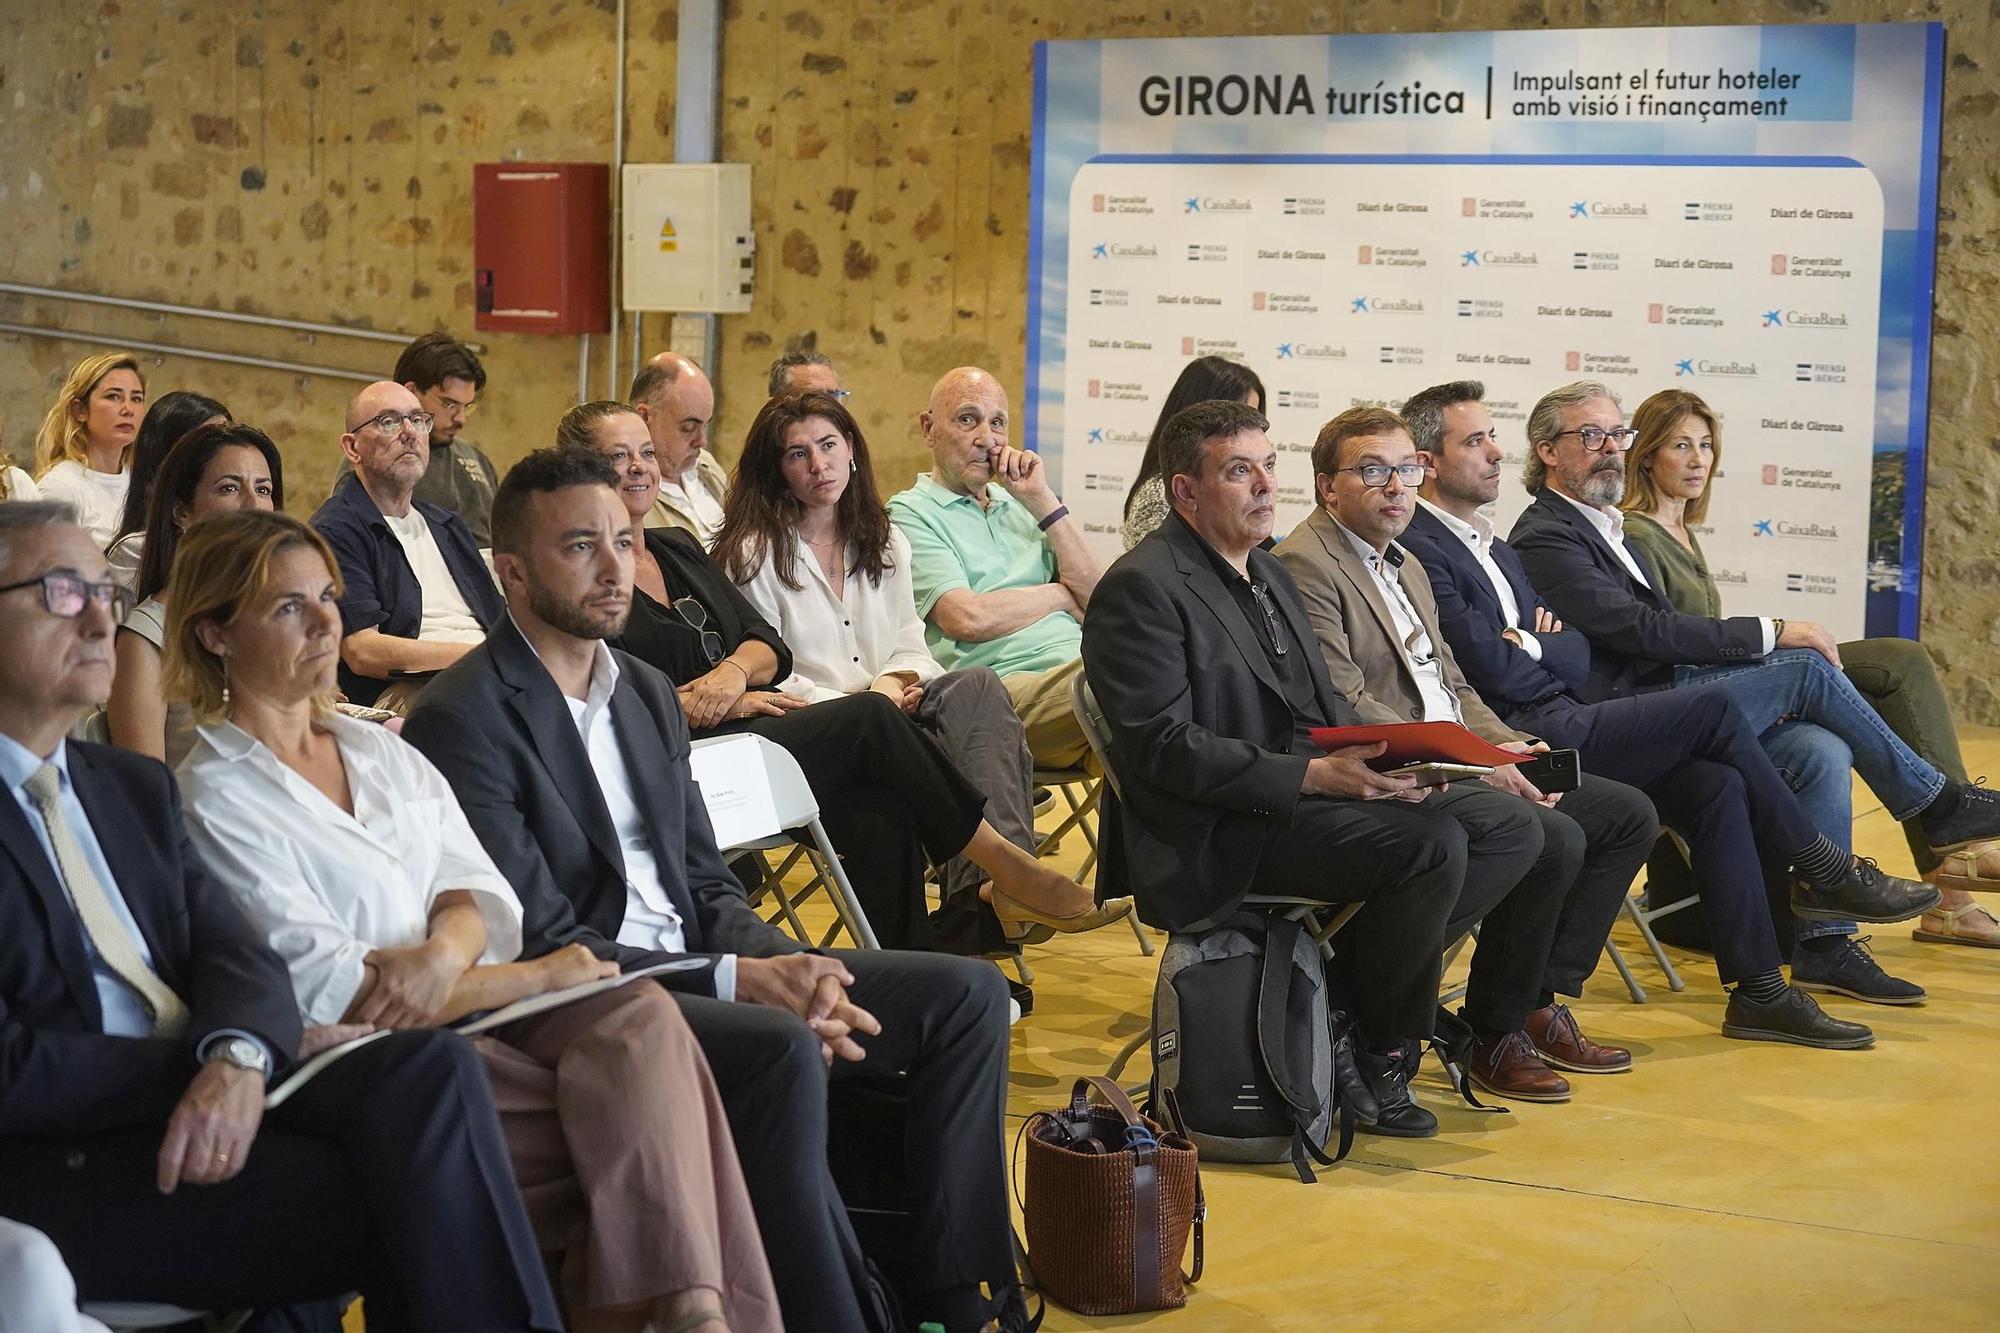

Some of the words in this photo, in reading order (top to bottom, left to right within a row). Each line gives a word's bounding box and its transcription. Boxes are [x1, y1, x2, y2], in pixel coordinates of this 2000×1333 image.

[1513, 70, 1623, 96] Impulsant
[1629, 69, 1648, 90] el
[1655, 69, 1711, 90] futur
[1718, 68, 1801, 90] hoteler
[1139, 74, 1316, 116] GIRONA
[1325, 80, 1465, 115] turística
[1512, 95, 1561, 116] amb
[1568, 94, 1619, 116] visió
[1626, 95, 1631, 116] i
[1638, 95, 1788, 123] finançament
[1203, 198, 1252, 210] CaixaBank
[1357, 203, 1381, 212] Diari
[1383, 203, 1394, 212] de
[1397, 204, 1428, 213] Girona
[1480, 199, 1526, 208] Generalitat
[1592, 201, 1648, 215] CaixaBank
[1480, 210, 1490, 218] de
[1493, 211, 1533, 220] Catalunya
[1771, 208, 1797, 218] Diari
[1800, 209, 1813, 218] de
[1816, 209, 1853, 219] Girona
[1110, 243, 1157, 256] CaixaBank
[1258, 250, 1280, 259] Diari
[1282, 251, 1293, 259] de
[1295, 251, 1326, 260] Girona
[1376, 247, 1419, 256] Generalitat
[1376, 258, 1384, 266] de
[1387, 258, 1426, 268] Catalunya
[1482, 250, 1539, 264] CaixaBank
[1791, 257, 1842, 266] Generalitat
[1654, 258, 1680, 268] Diari
[1682, 259, 1695, 268] de
[1697, 260, 1733, 270] Girona
[1791, 268, 1802, 276] de
[1805, 268, 1851, 279] Catalunya
[1372, 297, 1424, 311] CaixaBank
[1538, 306, 1562, 316] Diari
[1565, 307, 1576, 316] de
[1579, 308, 1612, 318] Girona
[1667, 306, 1715, 315] Generalitat
[1667, 317, 1677, 325] de
[1680, 317, 1724, 328] Catalunya
[1787, 310, 1848, 326] CaixaBank
[1297, 344, 1347, 357] CaixaBank
[1457, 353, 1480, 363] Diari
[1482, 354, 1494, 363] de
[1497, 354, 1531, 365] Girona
[1584, 353, 1631, 363] Generalitat
[1584, 364, 1594, 373] de
[1597, 365, 1638, 376] Catalunya
[1699, 360, 1758, 375] CaixaBank
[1761, 419, 1788, 429] Diari
[1791, 420, 1803, 430] de
[1807, 421, 1844, 432] Girona
[1782, 467, 1833, 478] Generalitat
[1782, 479, 1792, 487] de
[1795, 479, 1841, 491] Catalunya
[1777, 521, 1839, 537] CaixaBank
